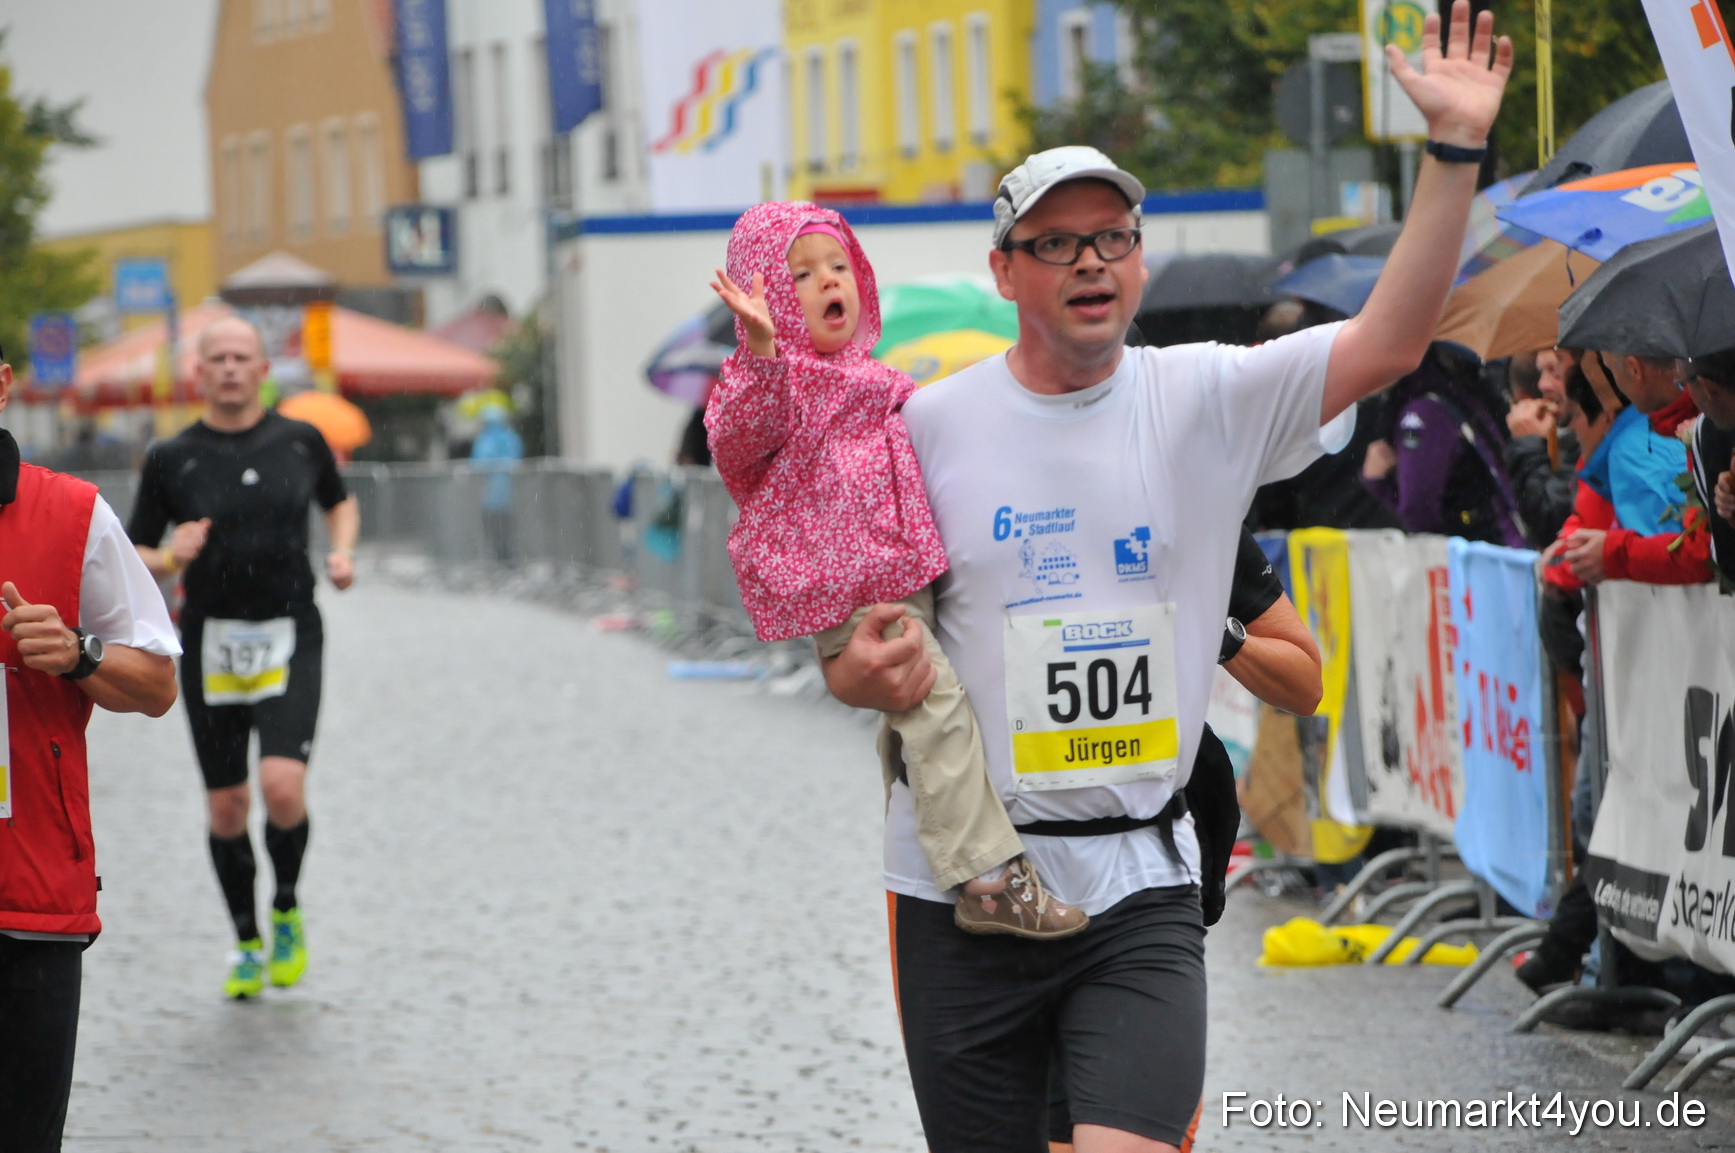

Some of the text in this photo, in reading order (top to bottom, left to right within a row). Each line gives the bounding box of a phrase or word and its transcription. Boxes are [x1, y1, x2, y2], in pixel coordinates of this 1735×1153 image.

[993, 506, 1076, 541] 6. Neumarkter
[1029, 519, 1075, 536] Stadtlauf
[1117, 561, 1147, 574] DKMS
[1062, 620, 1133, 641] BOCK
[219, 642, 271, 673] 397
[1047, 655, 1152, 724] 504
[1016, 720, 1023, 730] D
[1065, 737, 1140, 764] Jürgen
